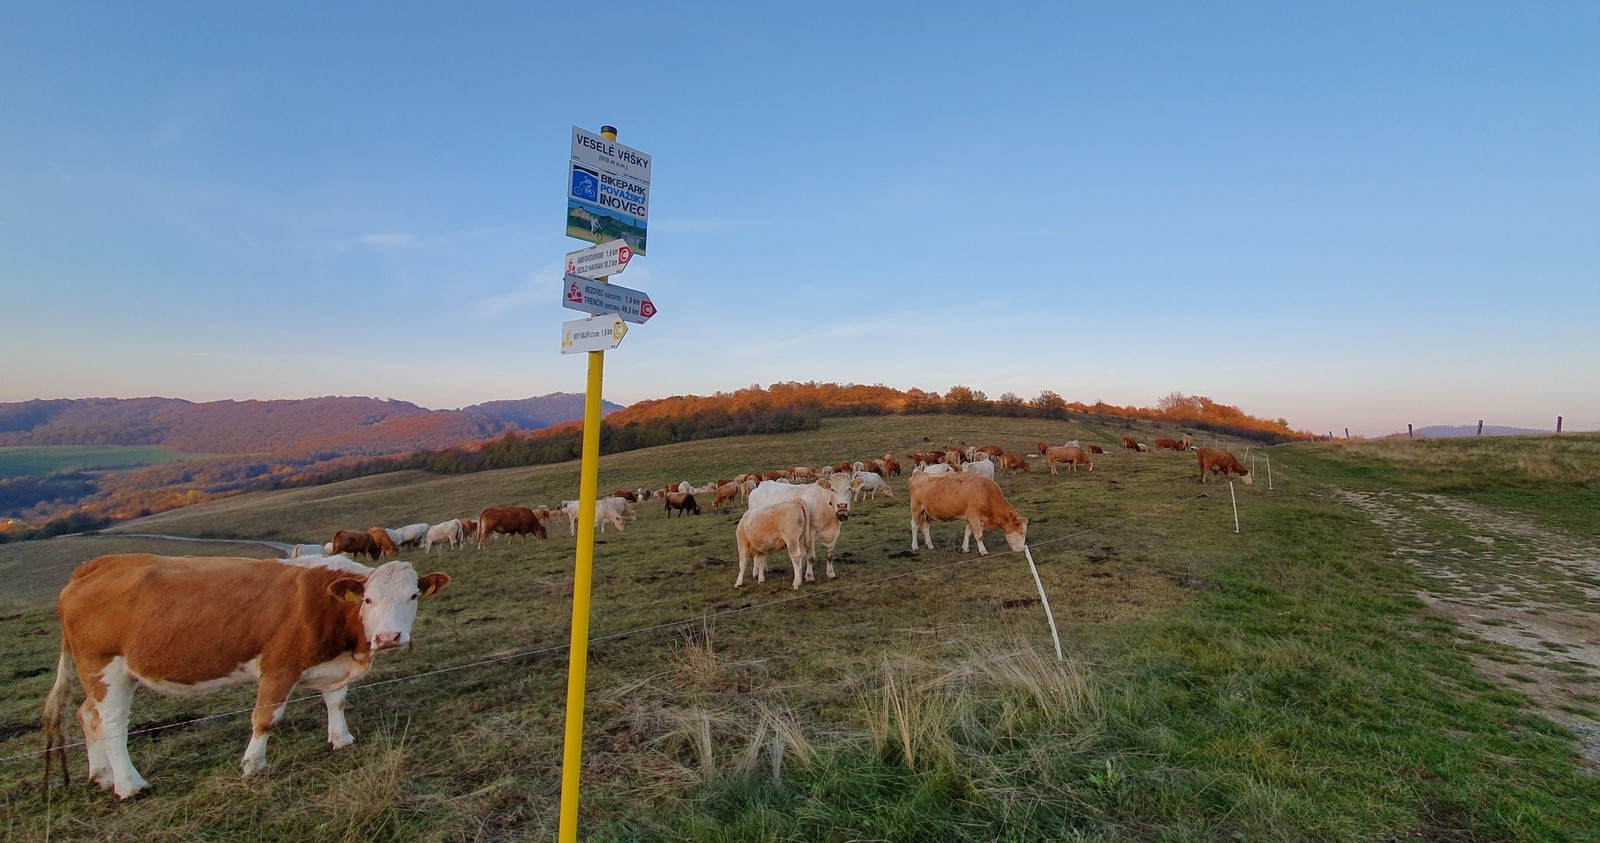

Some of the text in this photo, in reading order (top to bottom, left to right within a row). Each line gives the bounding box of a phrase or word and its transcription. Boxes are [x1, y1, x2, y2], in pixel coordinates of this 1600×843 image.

[576, 133, 649, 169] VESELÉ VŔŠKY
[600, 184, 646, 205] POVAŽSKÝ
[601, 173, 646, 197] BIKEPARK
[599, 193, 646, 217] INOVEC
[584, 285, 604, 298] BEZOVEC
[633, 297, 640, 306] km
[632, 307, 640, 316] km
